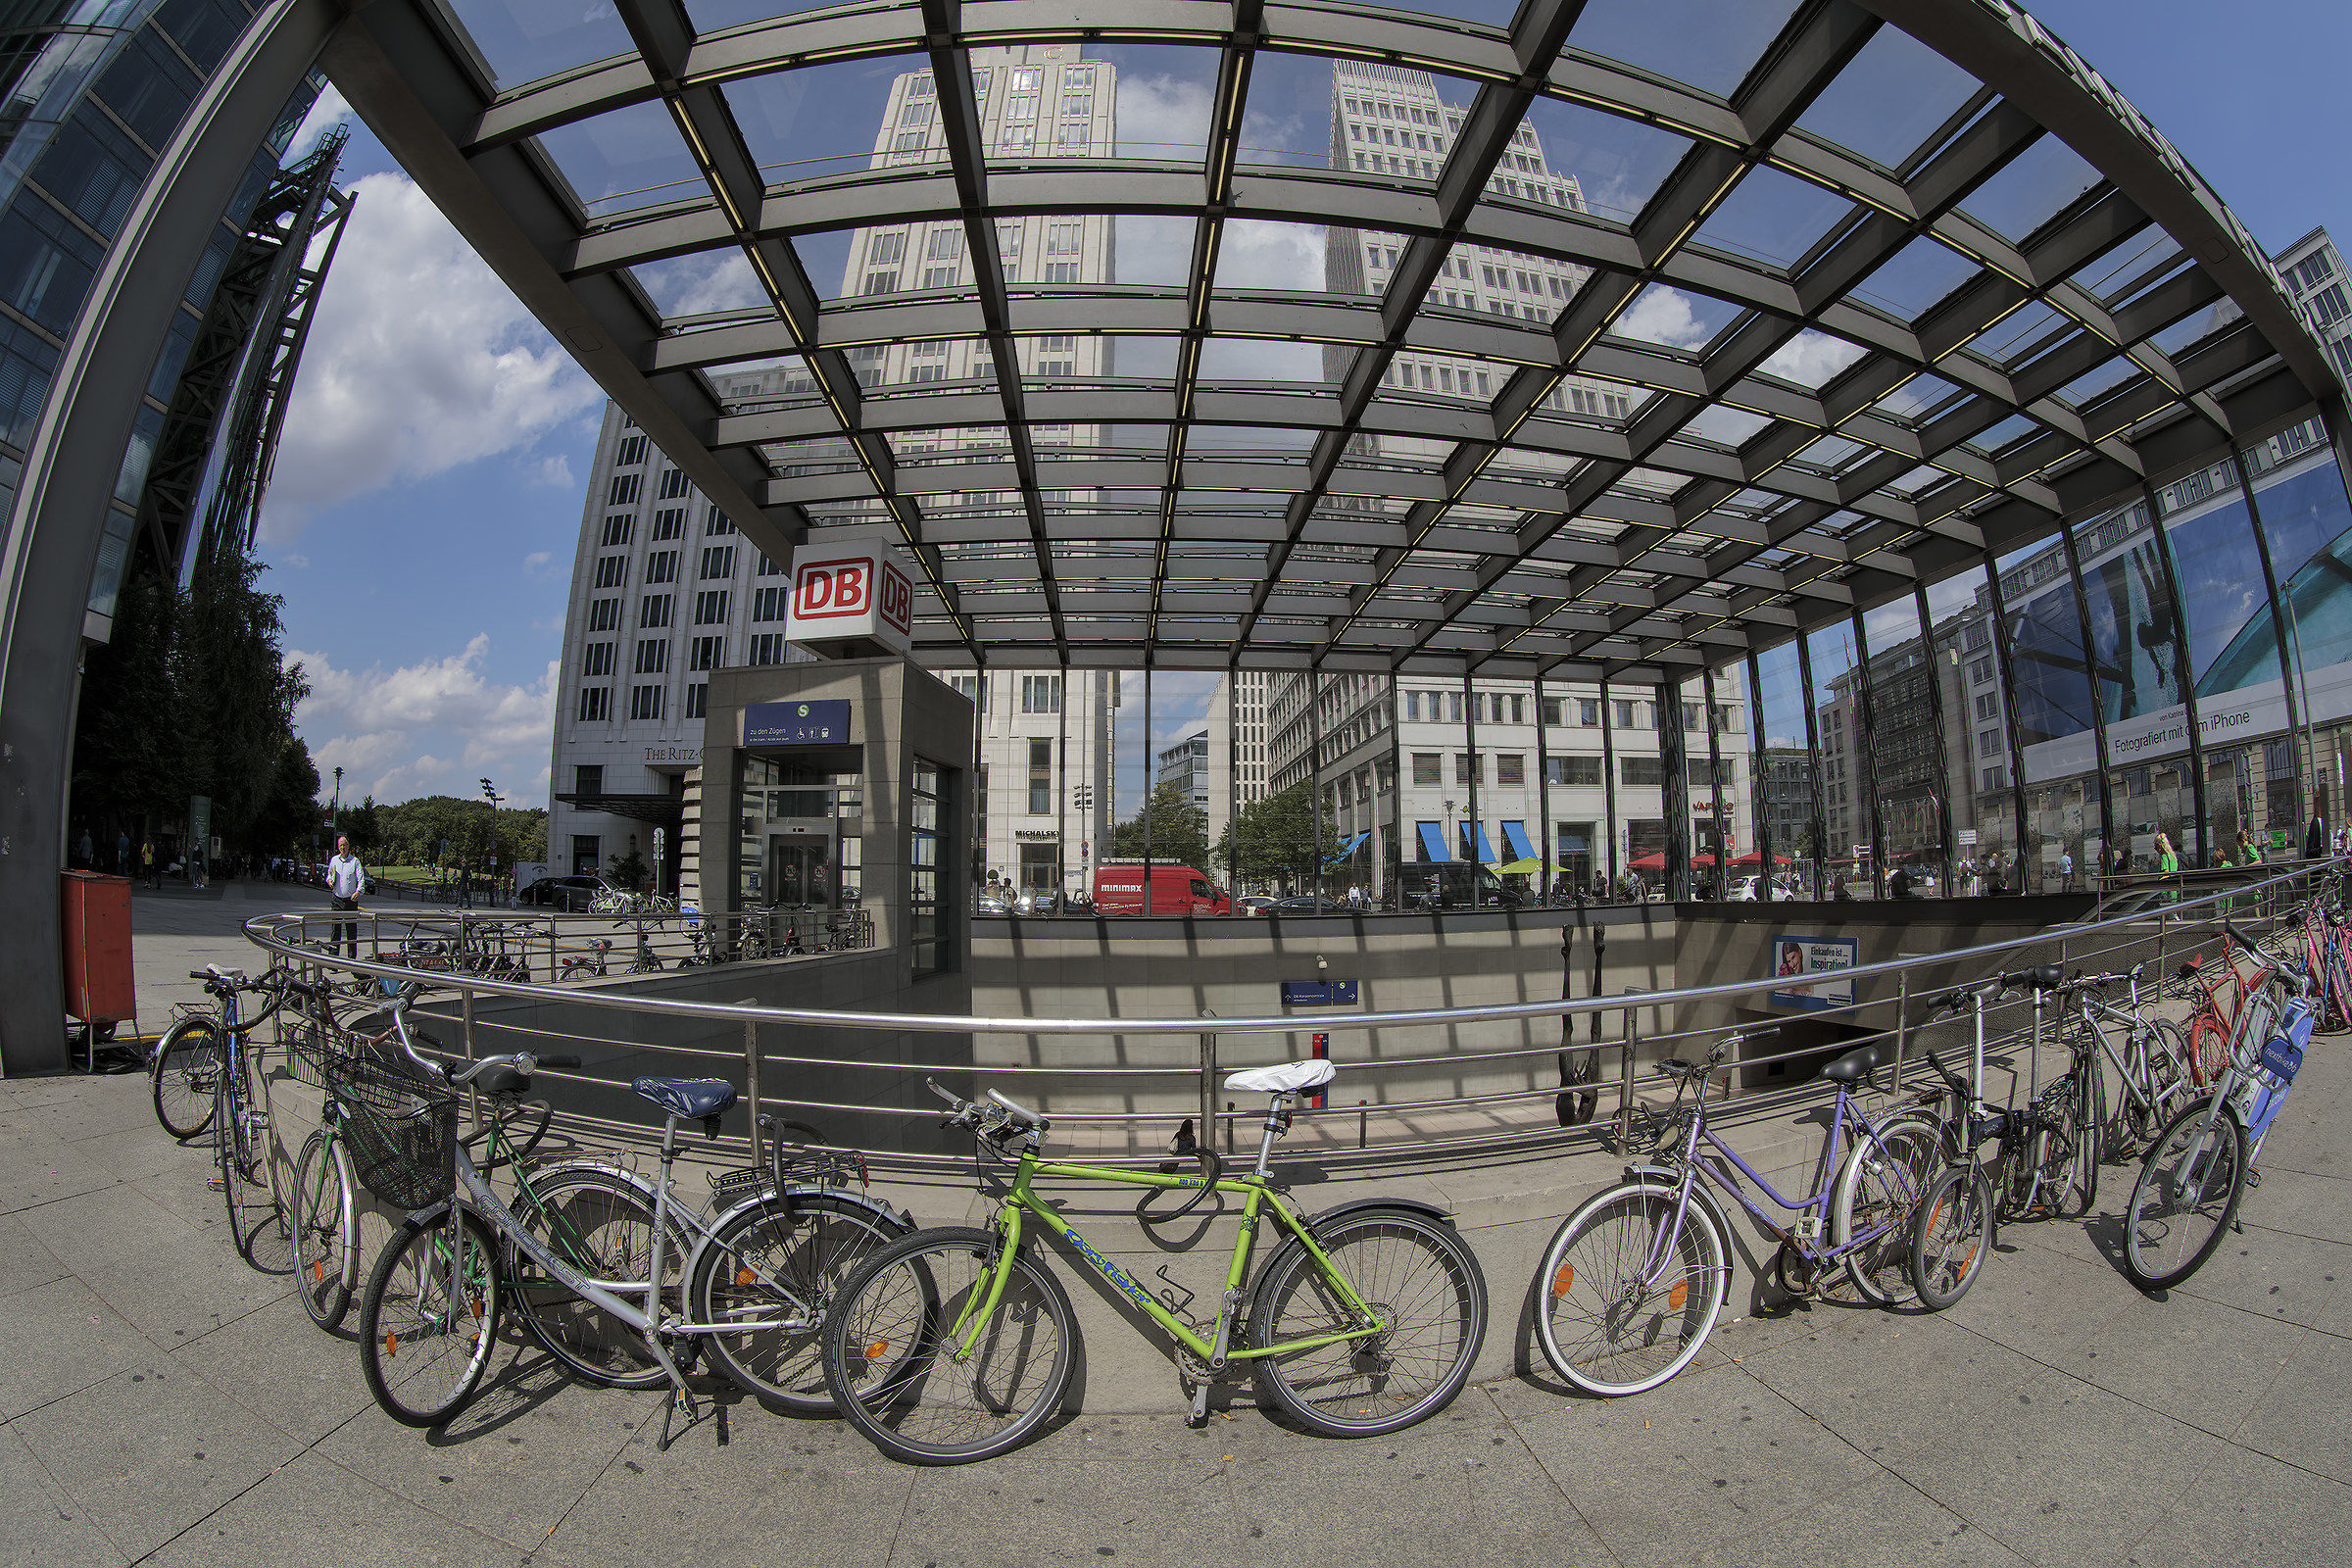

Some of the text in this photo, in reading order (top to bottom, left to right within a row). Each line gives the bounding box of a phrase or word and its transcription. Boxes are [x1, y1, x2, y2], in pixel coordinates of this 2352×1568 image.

[804, 567, 862, 610] DB
[884, 571, 908, 623] DB
[768, 727, 786, 736] Zügen
[2115, 711, 2250, 753] Fotografiert mit dm iPhone
[645, 747, 665, 760] THE
[1811, 947, 1836, 956] Einkaufen
